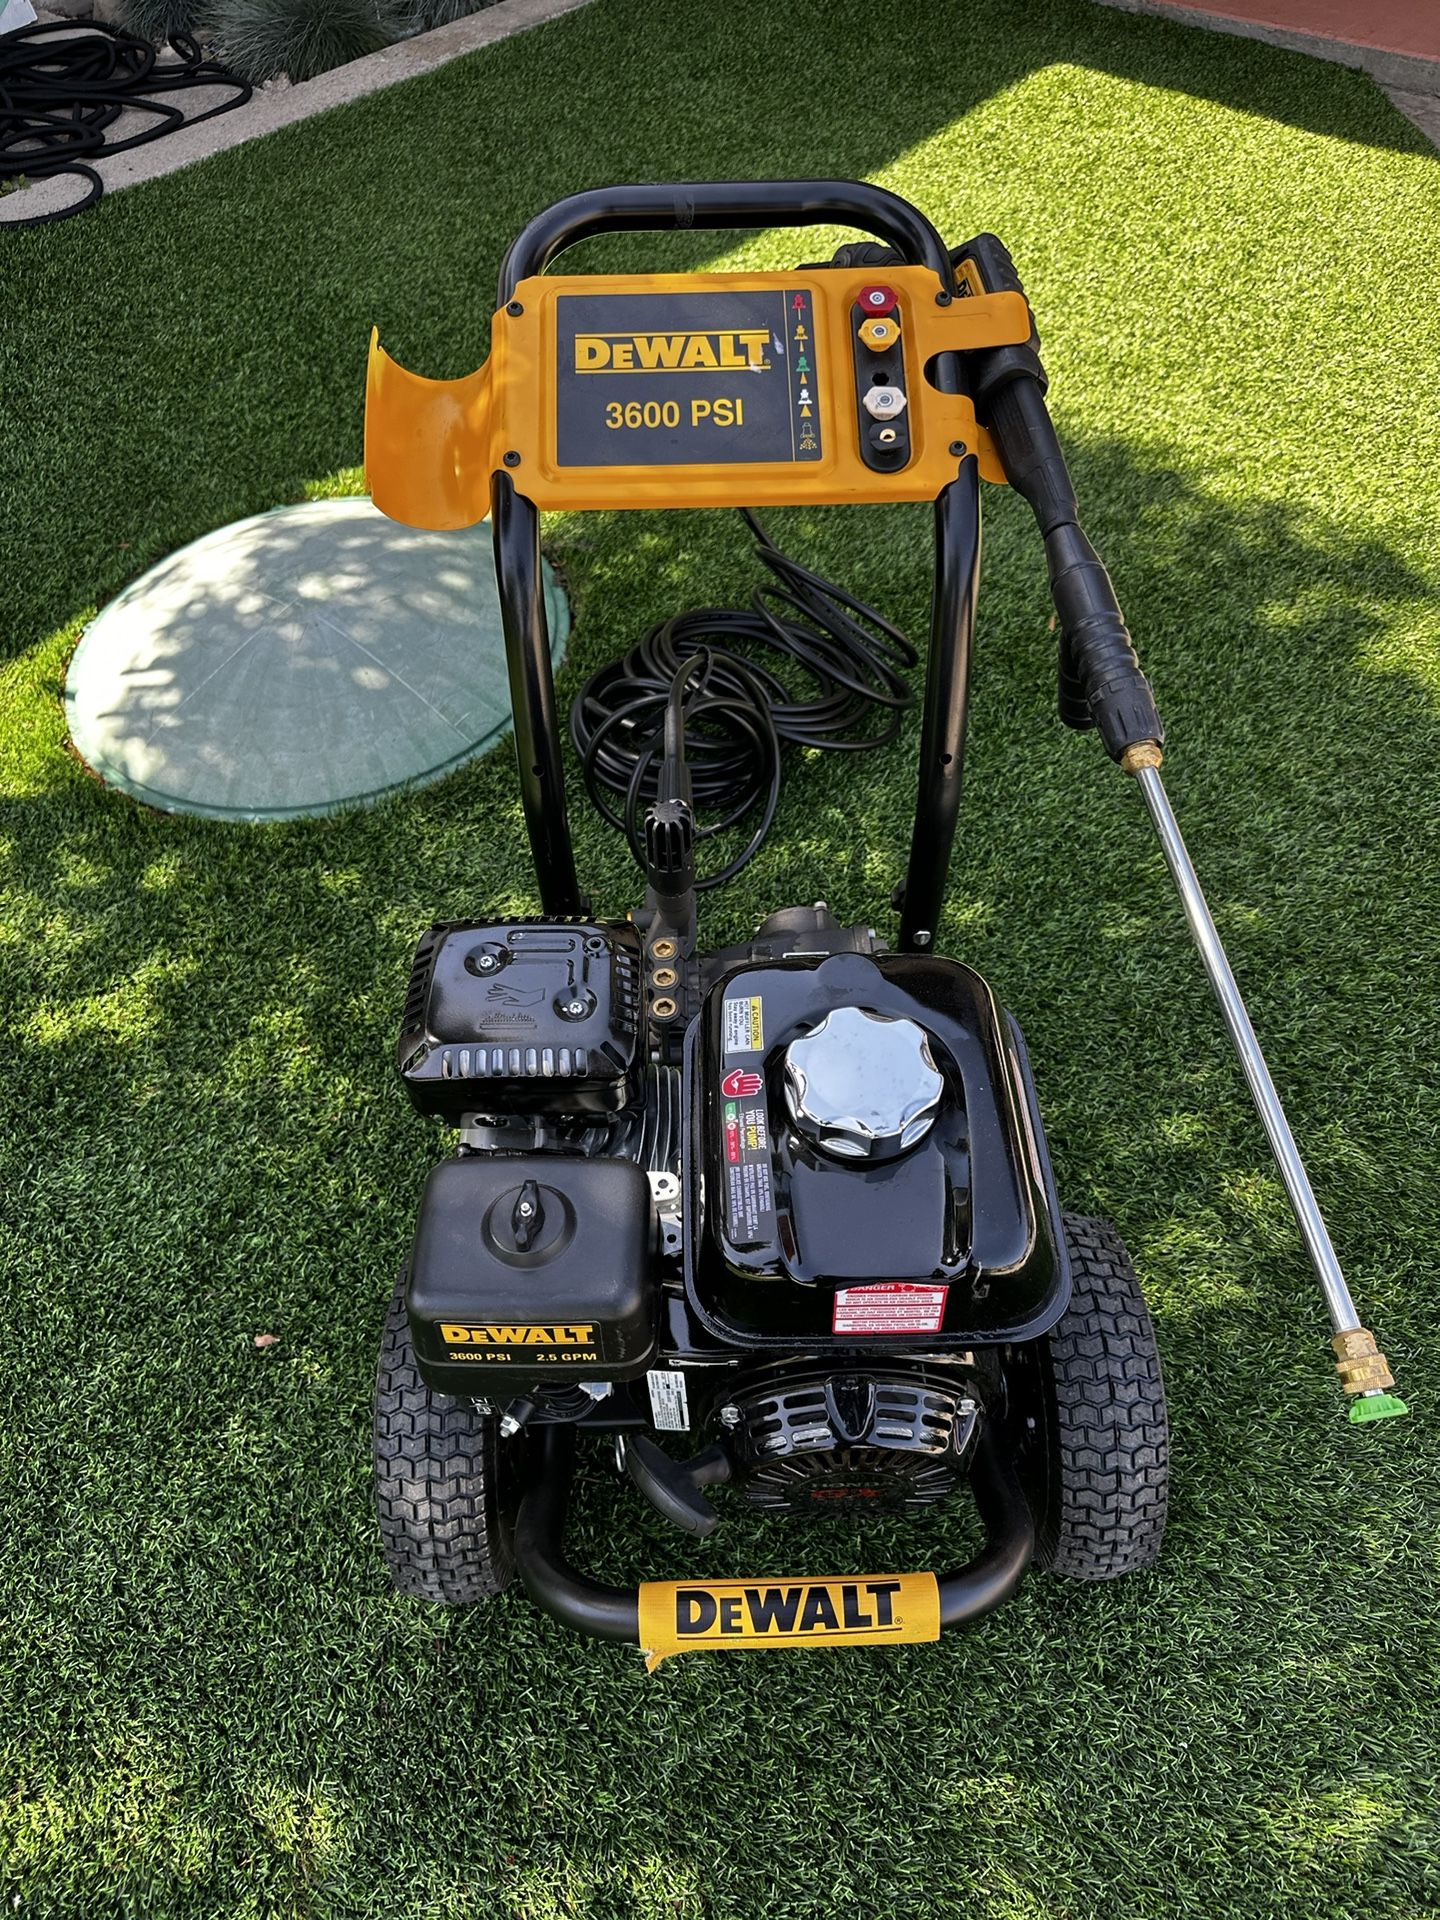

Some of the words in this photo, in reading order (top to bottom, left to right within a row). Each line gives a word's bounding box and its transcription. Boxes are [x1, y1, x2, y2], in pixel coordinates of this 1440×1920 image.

[575, 335, 769, 369] DEWALT
[605, 401, 680, 429] 3600
[691, 399, 743, 426] PSI
[751, 1012, 760, 1041] CAUTION
[745, 1109, 756, 1125] YOU
[756, 1109, 765, 1125] LOOK
[746, 1125, 758, 1151] PUMP!
[757, 1125, 767, 1150] BEFORE
[442, 1326, 594, 1343] DEWALT
[449, 1352, 482, 1361] 3600
[486, 1352, 511, 1362] PSI
[536, 1353, 558, 1362] 2.5
[561, 1353, 597, 1362] GPM
[676, 1583, 901, 1634] DEWALT
